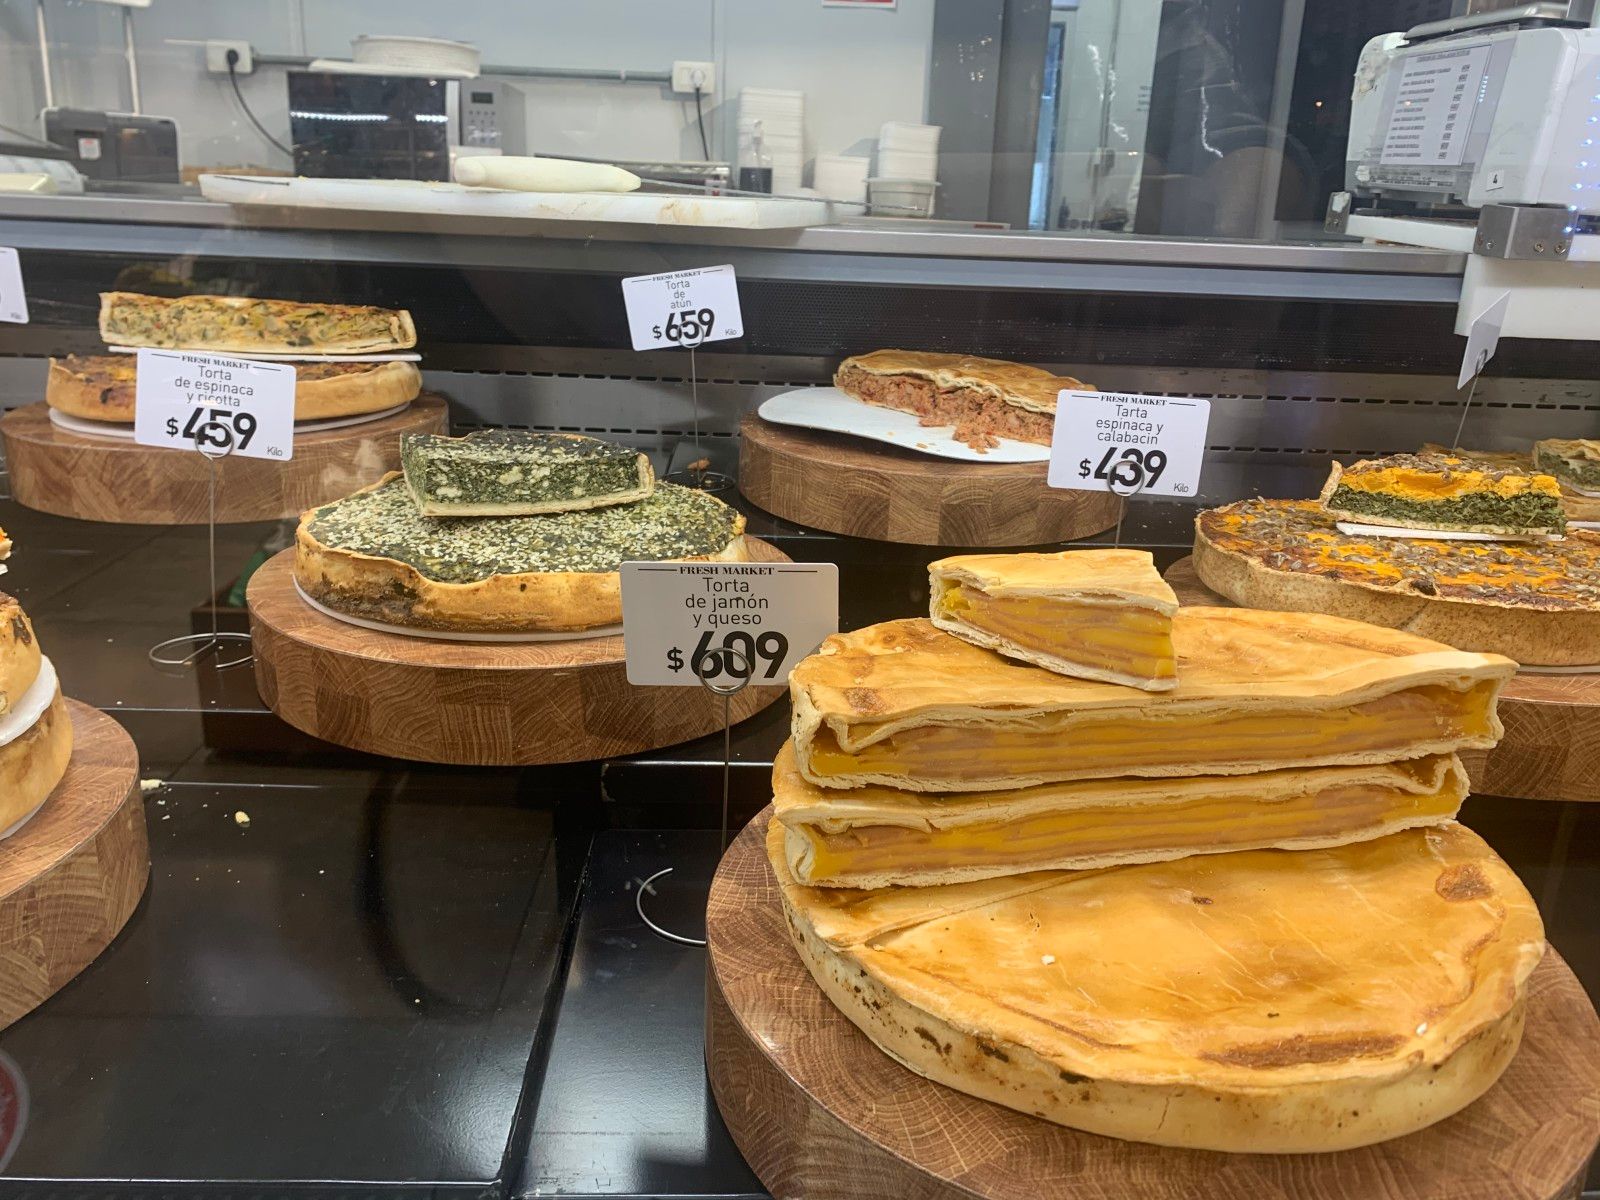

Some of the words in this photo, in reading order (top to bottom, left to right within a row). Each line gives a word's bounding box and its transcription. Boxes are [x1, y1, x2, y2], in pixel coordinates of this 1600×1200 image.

[675, 270, 701, 279] MARKET
[666, 280, 691, 290] Torta
[673, 290, 686, 299] de
[670, 298, 692, 309] atún
[181, 354, 211, 365] FRESH
[213, 358, 251, 370] MARKET
[198, 365, 232, 381] Torta
[174, 376, 191, 389] de
[194, 380, 254, 396] espinaca
[186, 392, 194, 404] y
[197, 392, 240, 407] ricotta
[1100, 394, 1129, 404] FRESH
[1131, 396, 1168, 407] MARKET
[1115, 404, 1148, 419] Tarta
[1096, 417, 1153, 432] espinaca
[1156, 423, 1164, 436] y
[266, 446, 283, 456] Kilo
[1173, 483, 1189, 493] Kilo
[679, 566, 719, 576] FRESH
[722, 566, 775, 576] MARKET
[702, 577, 750, 593] Torta
[685, 594, 706, 609] de
[711, 592, 769, 613] jamón
[692, 612, 702, 628] y
[707, 612, 762, 629] queso
